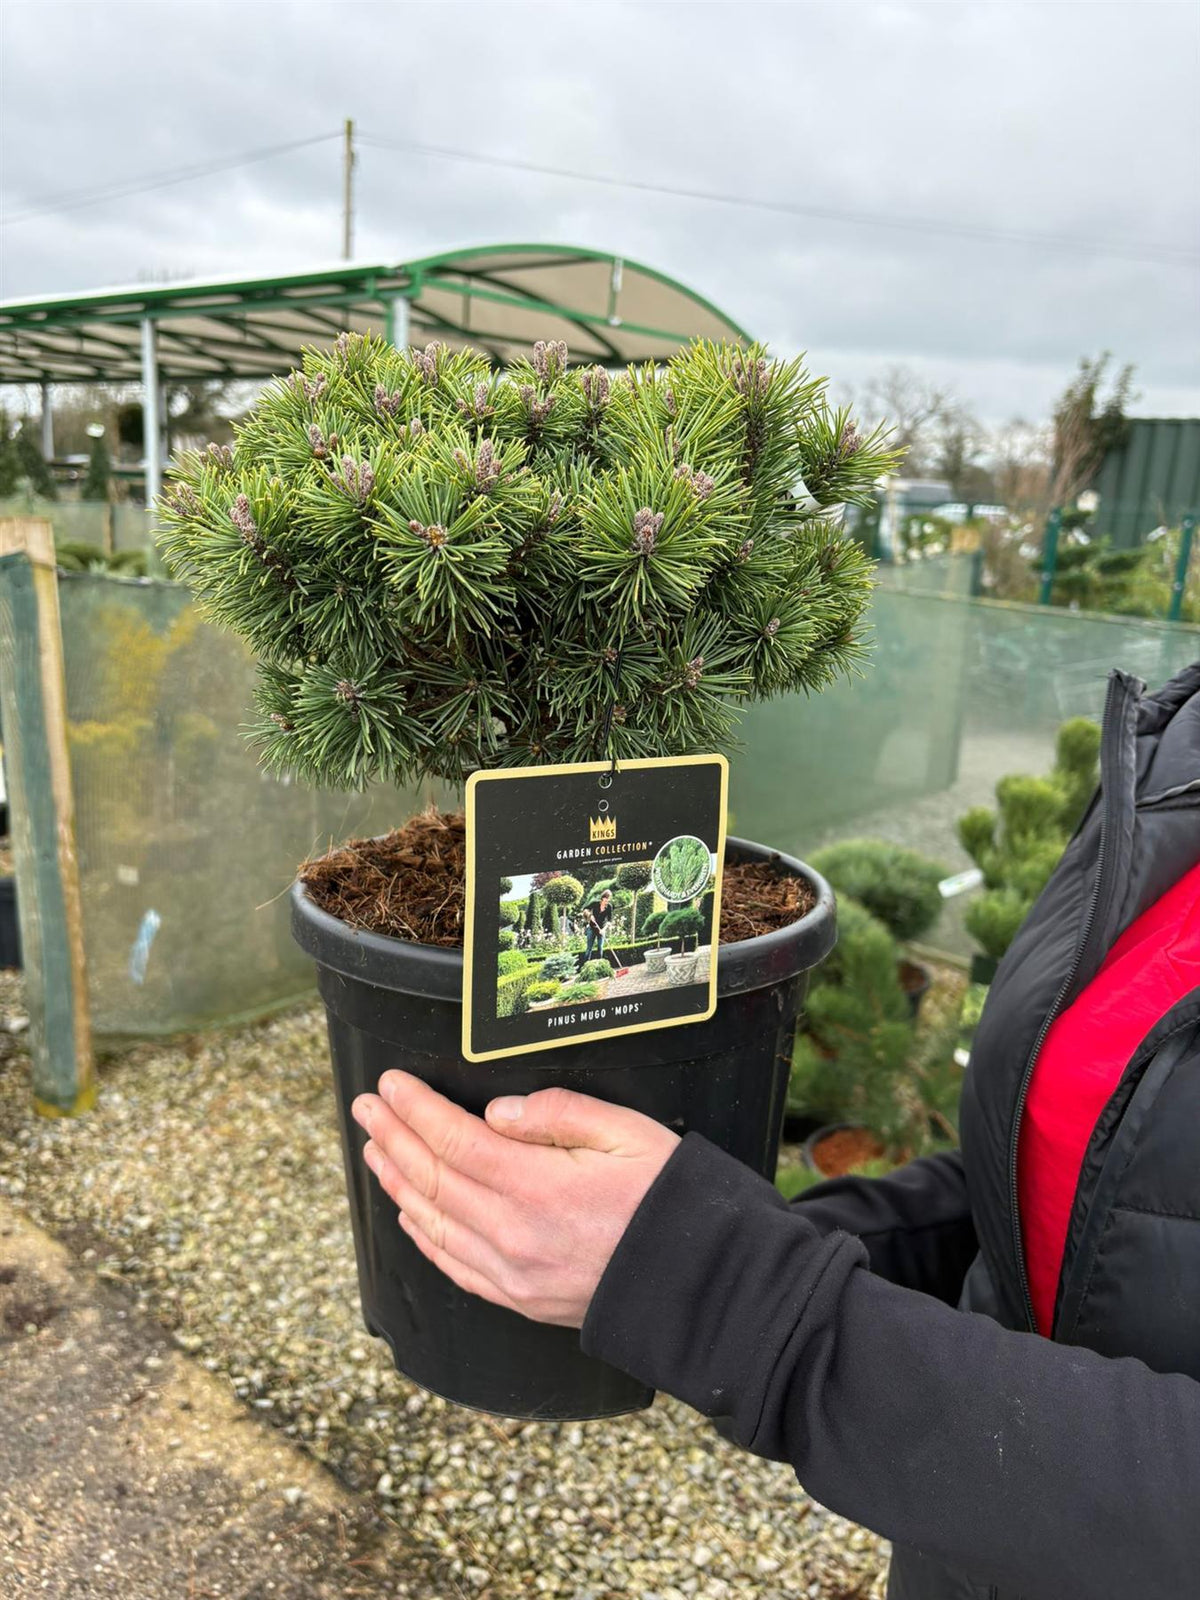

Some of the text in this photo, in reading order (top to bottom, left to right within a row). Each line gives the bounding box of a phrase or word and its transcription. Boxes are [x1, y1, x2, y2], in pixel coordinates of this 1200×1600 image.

[592, 829, 615, 839] KINGS
[556, 847, 592, 860] GARDEN
[547, 1013, 576, 1028] PINUS
[580, 1008, 607, 1022] MUGO
